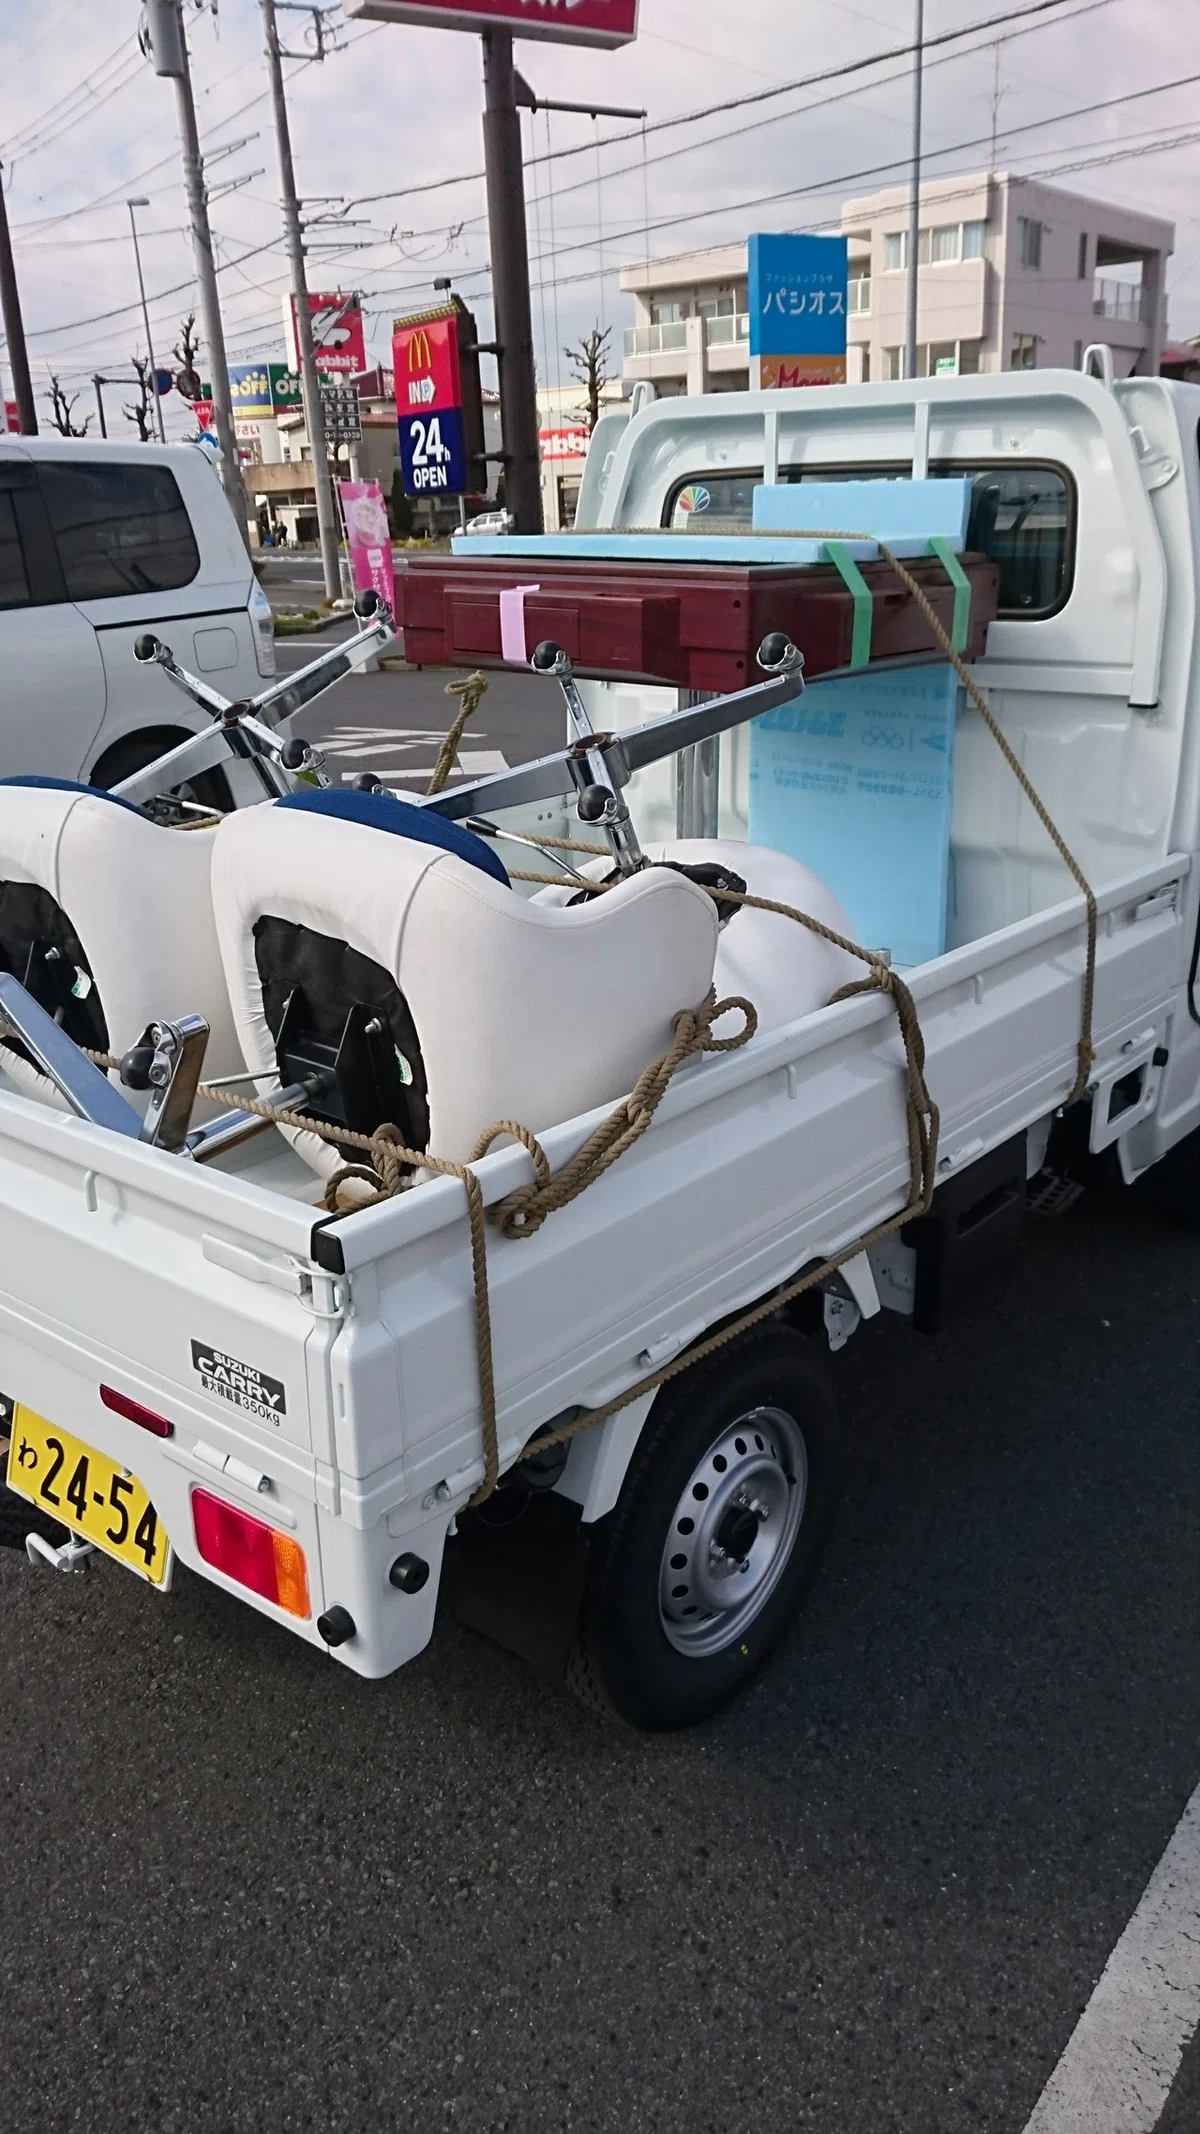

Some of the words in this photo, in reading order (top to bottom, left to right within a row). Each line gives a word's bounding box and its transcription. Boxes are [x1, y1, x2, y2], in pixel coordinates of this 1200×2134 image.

[763, 288, 844, 315] パシオス
[413, 465, 447, 488] OPEN
[198, 1356, 281, 1408] CARRY
[213, 1351, 260, 1383] SUZUKI
[18, 1436, 38, 1469] わ
[41, 1437, 157, 1567] 24-54
